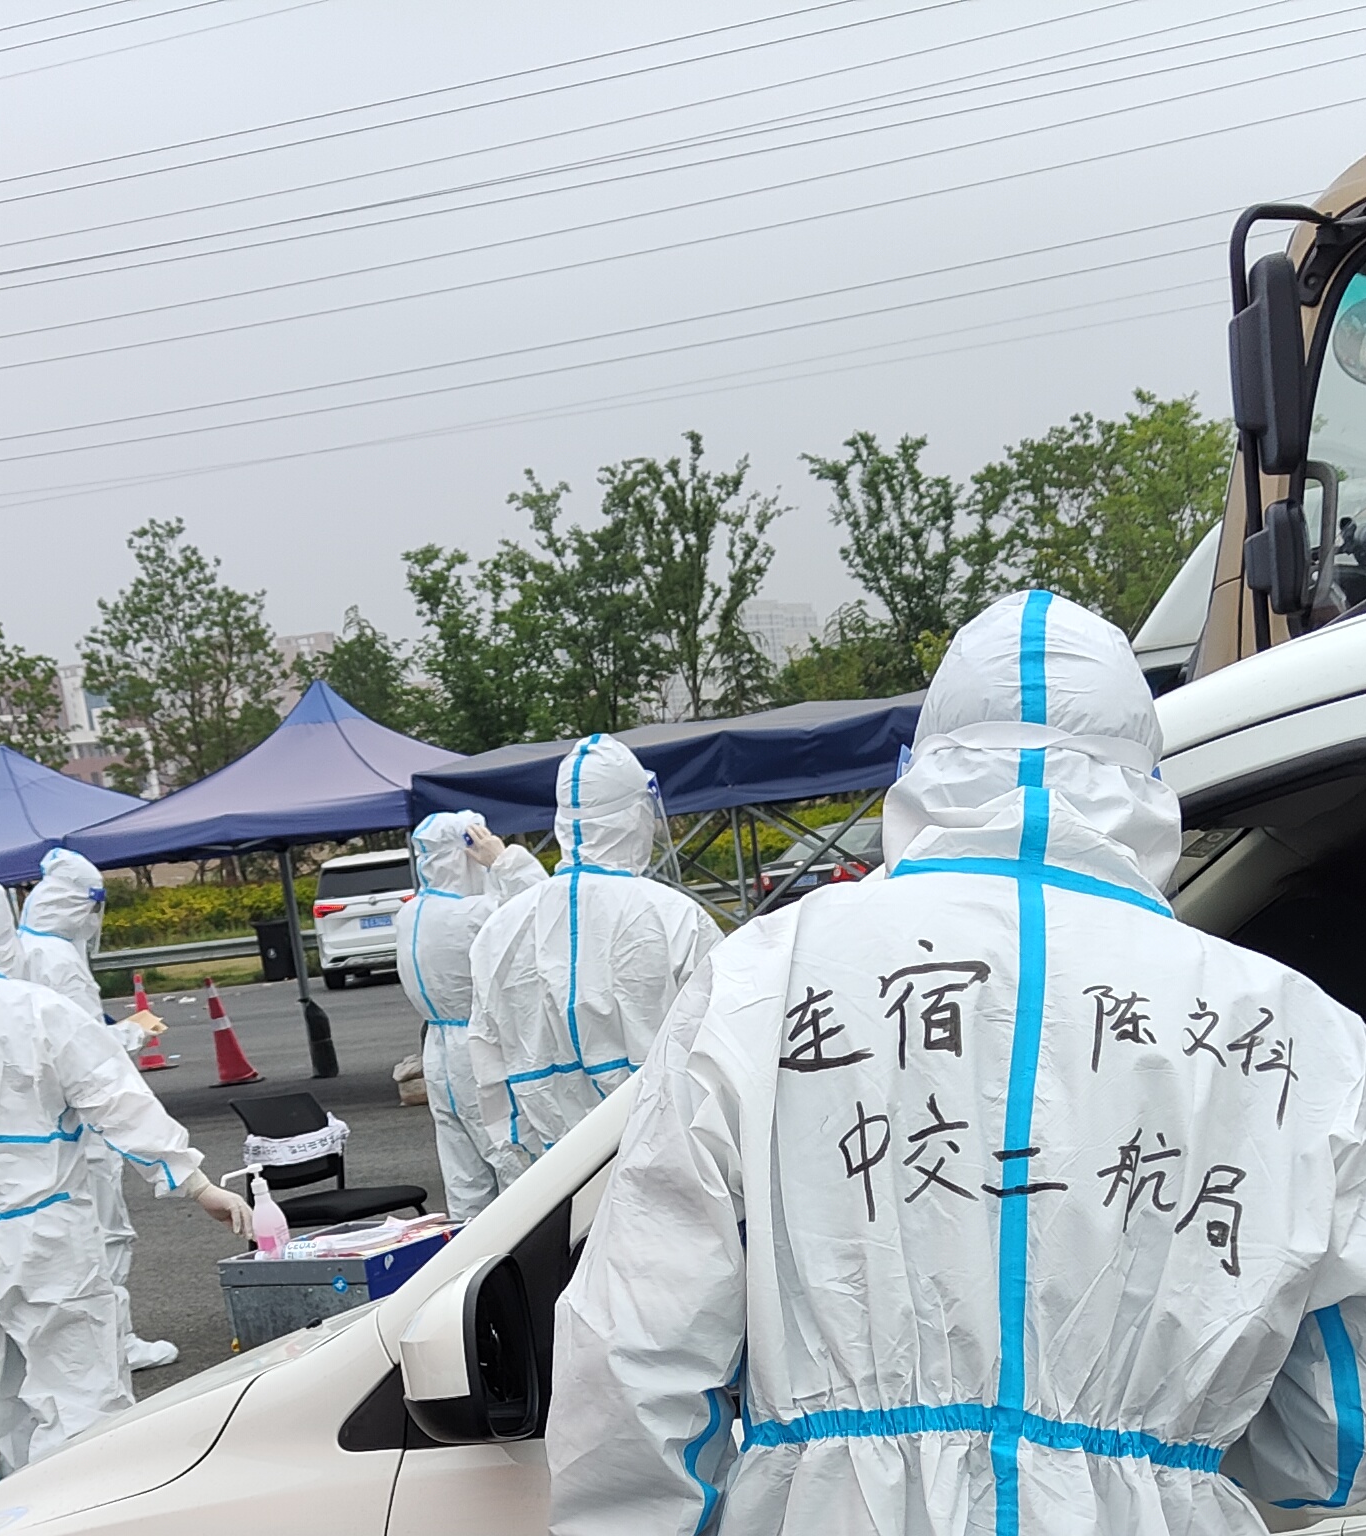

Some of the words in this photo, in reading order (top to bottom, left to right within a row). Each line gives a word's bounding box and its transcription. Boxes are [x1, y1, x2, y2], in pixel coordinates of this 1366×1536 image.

[837, 1092, 1248, 1278] 中交二航局
